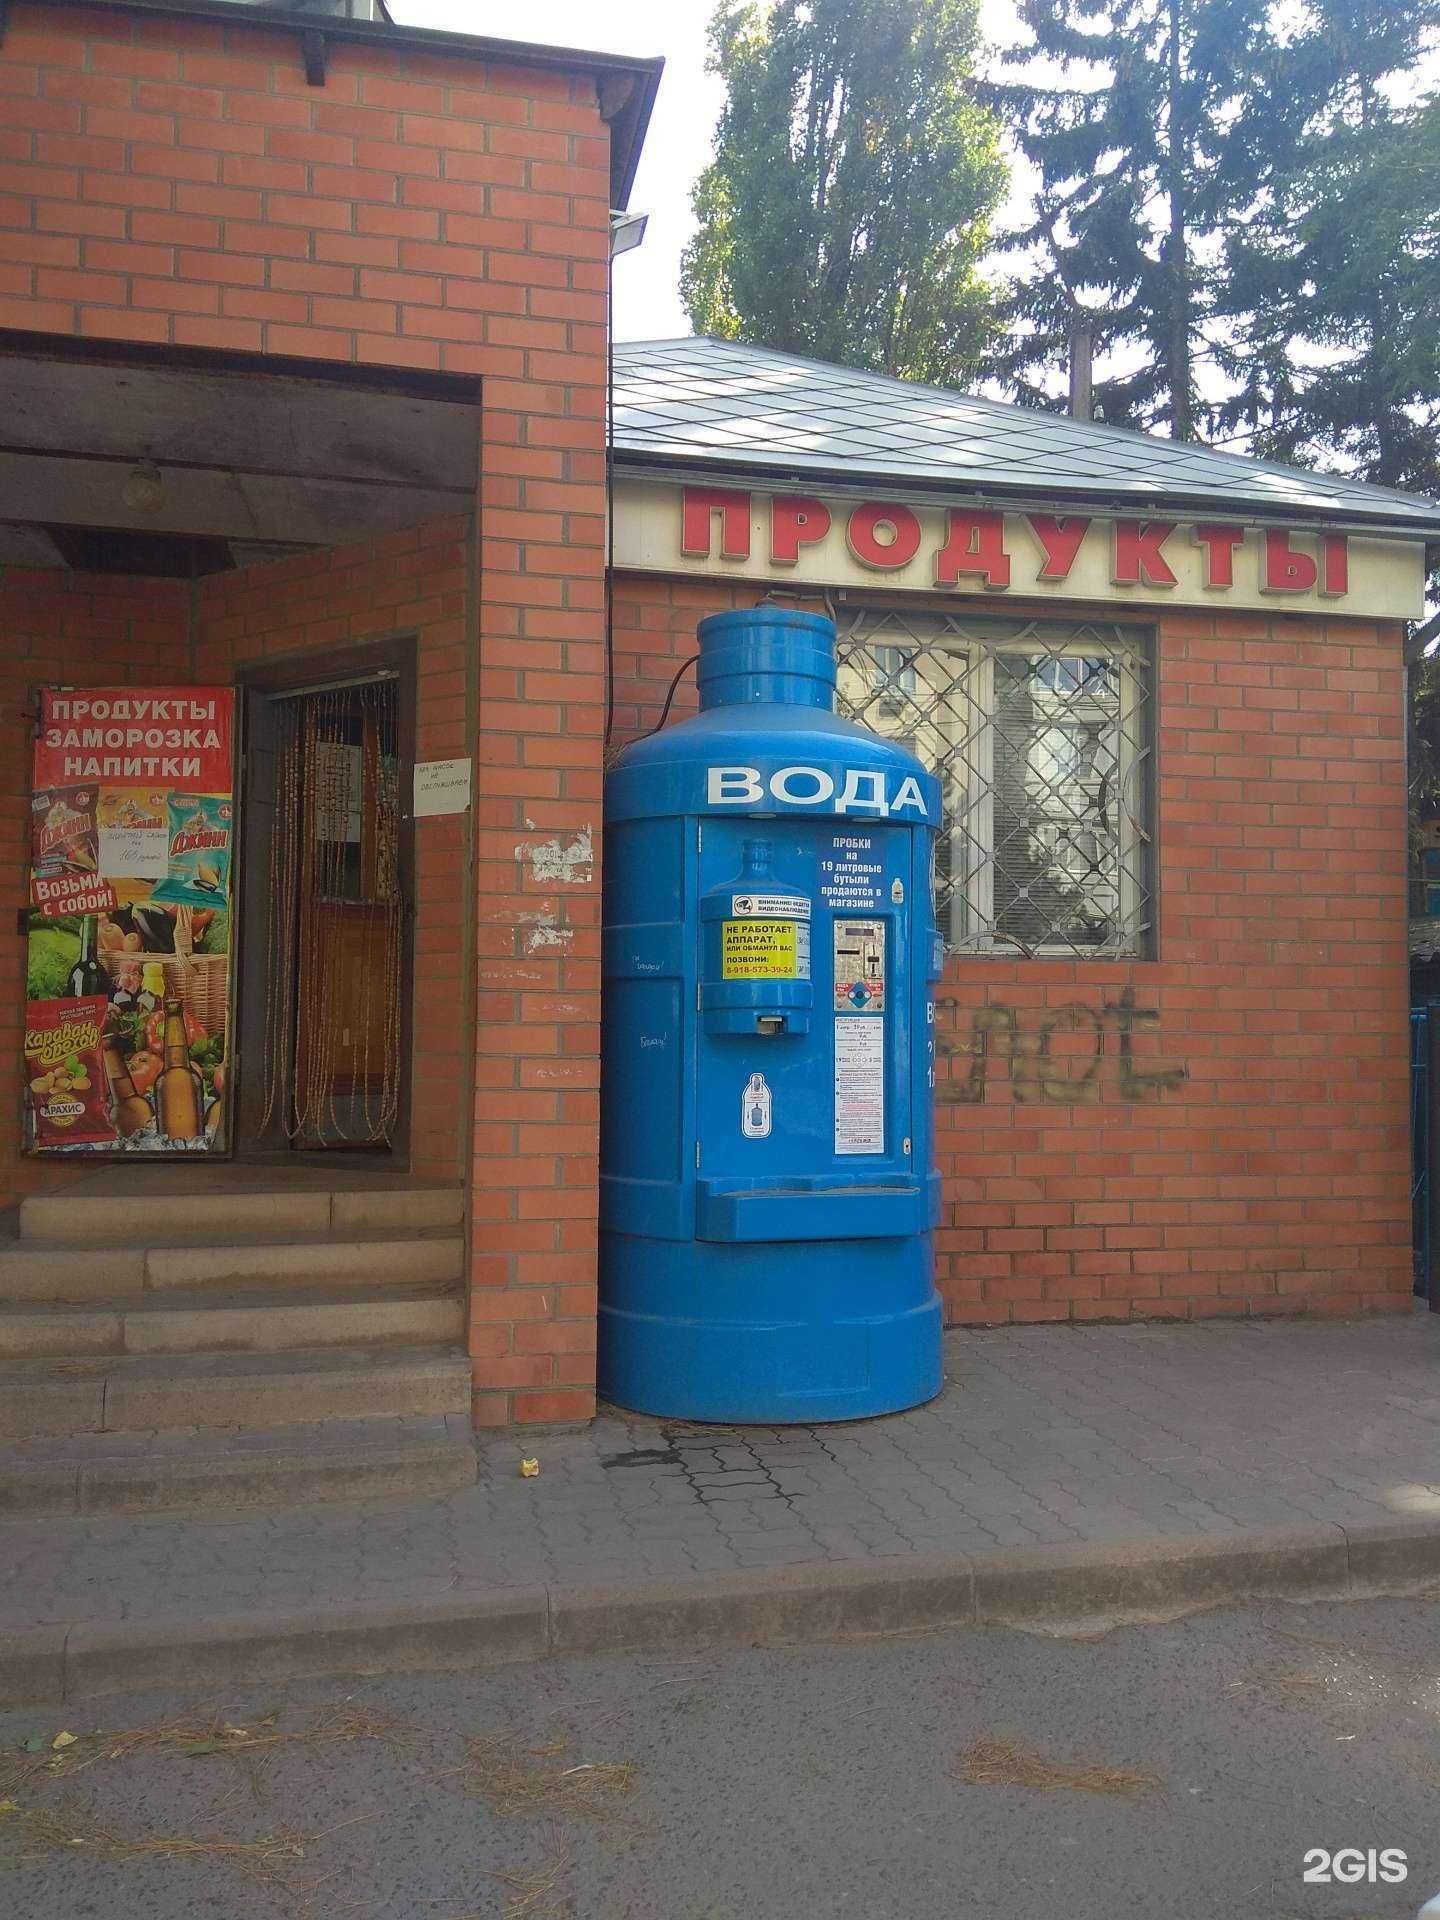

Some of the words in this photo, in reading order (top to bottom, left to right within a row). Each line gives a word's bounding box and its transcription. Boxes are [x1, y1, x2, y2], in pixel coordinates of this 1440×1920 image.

[681, 486, 1348, 598] ПРОДУКТЫ
[52, 700, 216, 720] ПРОДУКТЫ
[46, 728, 221, 748] ЗАМОРОЗКА
[64, 757, 200, 777] НАПИТКИ
[707, 766, 928, 817] ВОДА
[833, 837, 871, 849] ПРОБКИ
[846, 852, 858, 861] на
[821, 861, 833, 872] 19
[836, 862, 882, 874] литровые
[833, 874, 869, 885] бутыли
[821, 886, 872, 898] продаются
[876, 888, 882, 897] в
[44, 902, 53, 915] с
[59, 889, 113, 914] собой!
[829, 898, 874, 909] магазине
[726, 926, 739, 934] НЕ
[741, 925, 793, 934] РАБОТАЕТ
[726, 935, 776, 945] АППАРАТ,
[43, 1103, 82, 1116] АРАХИС
